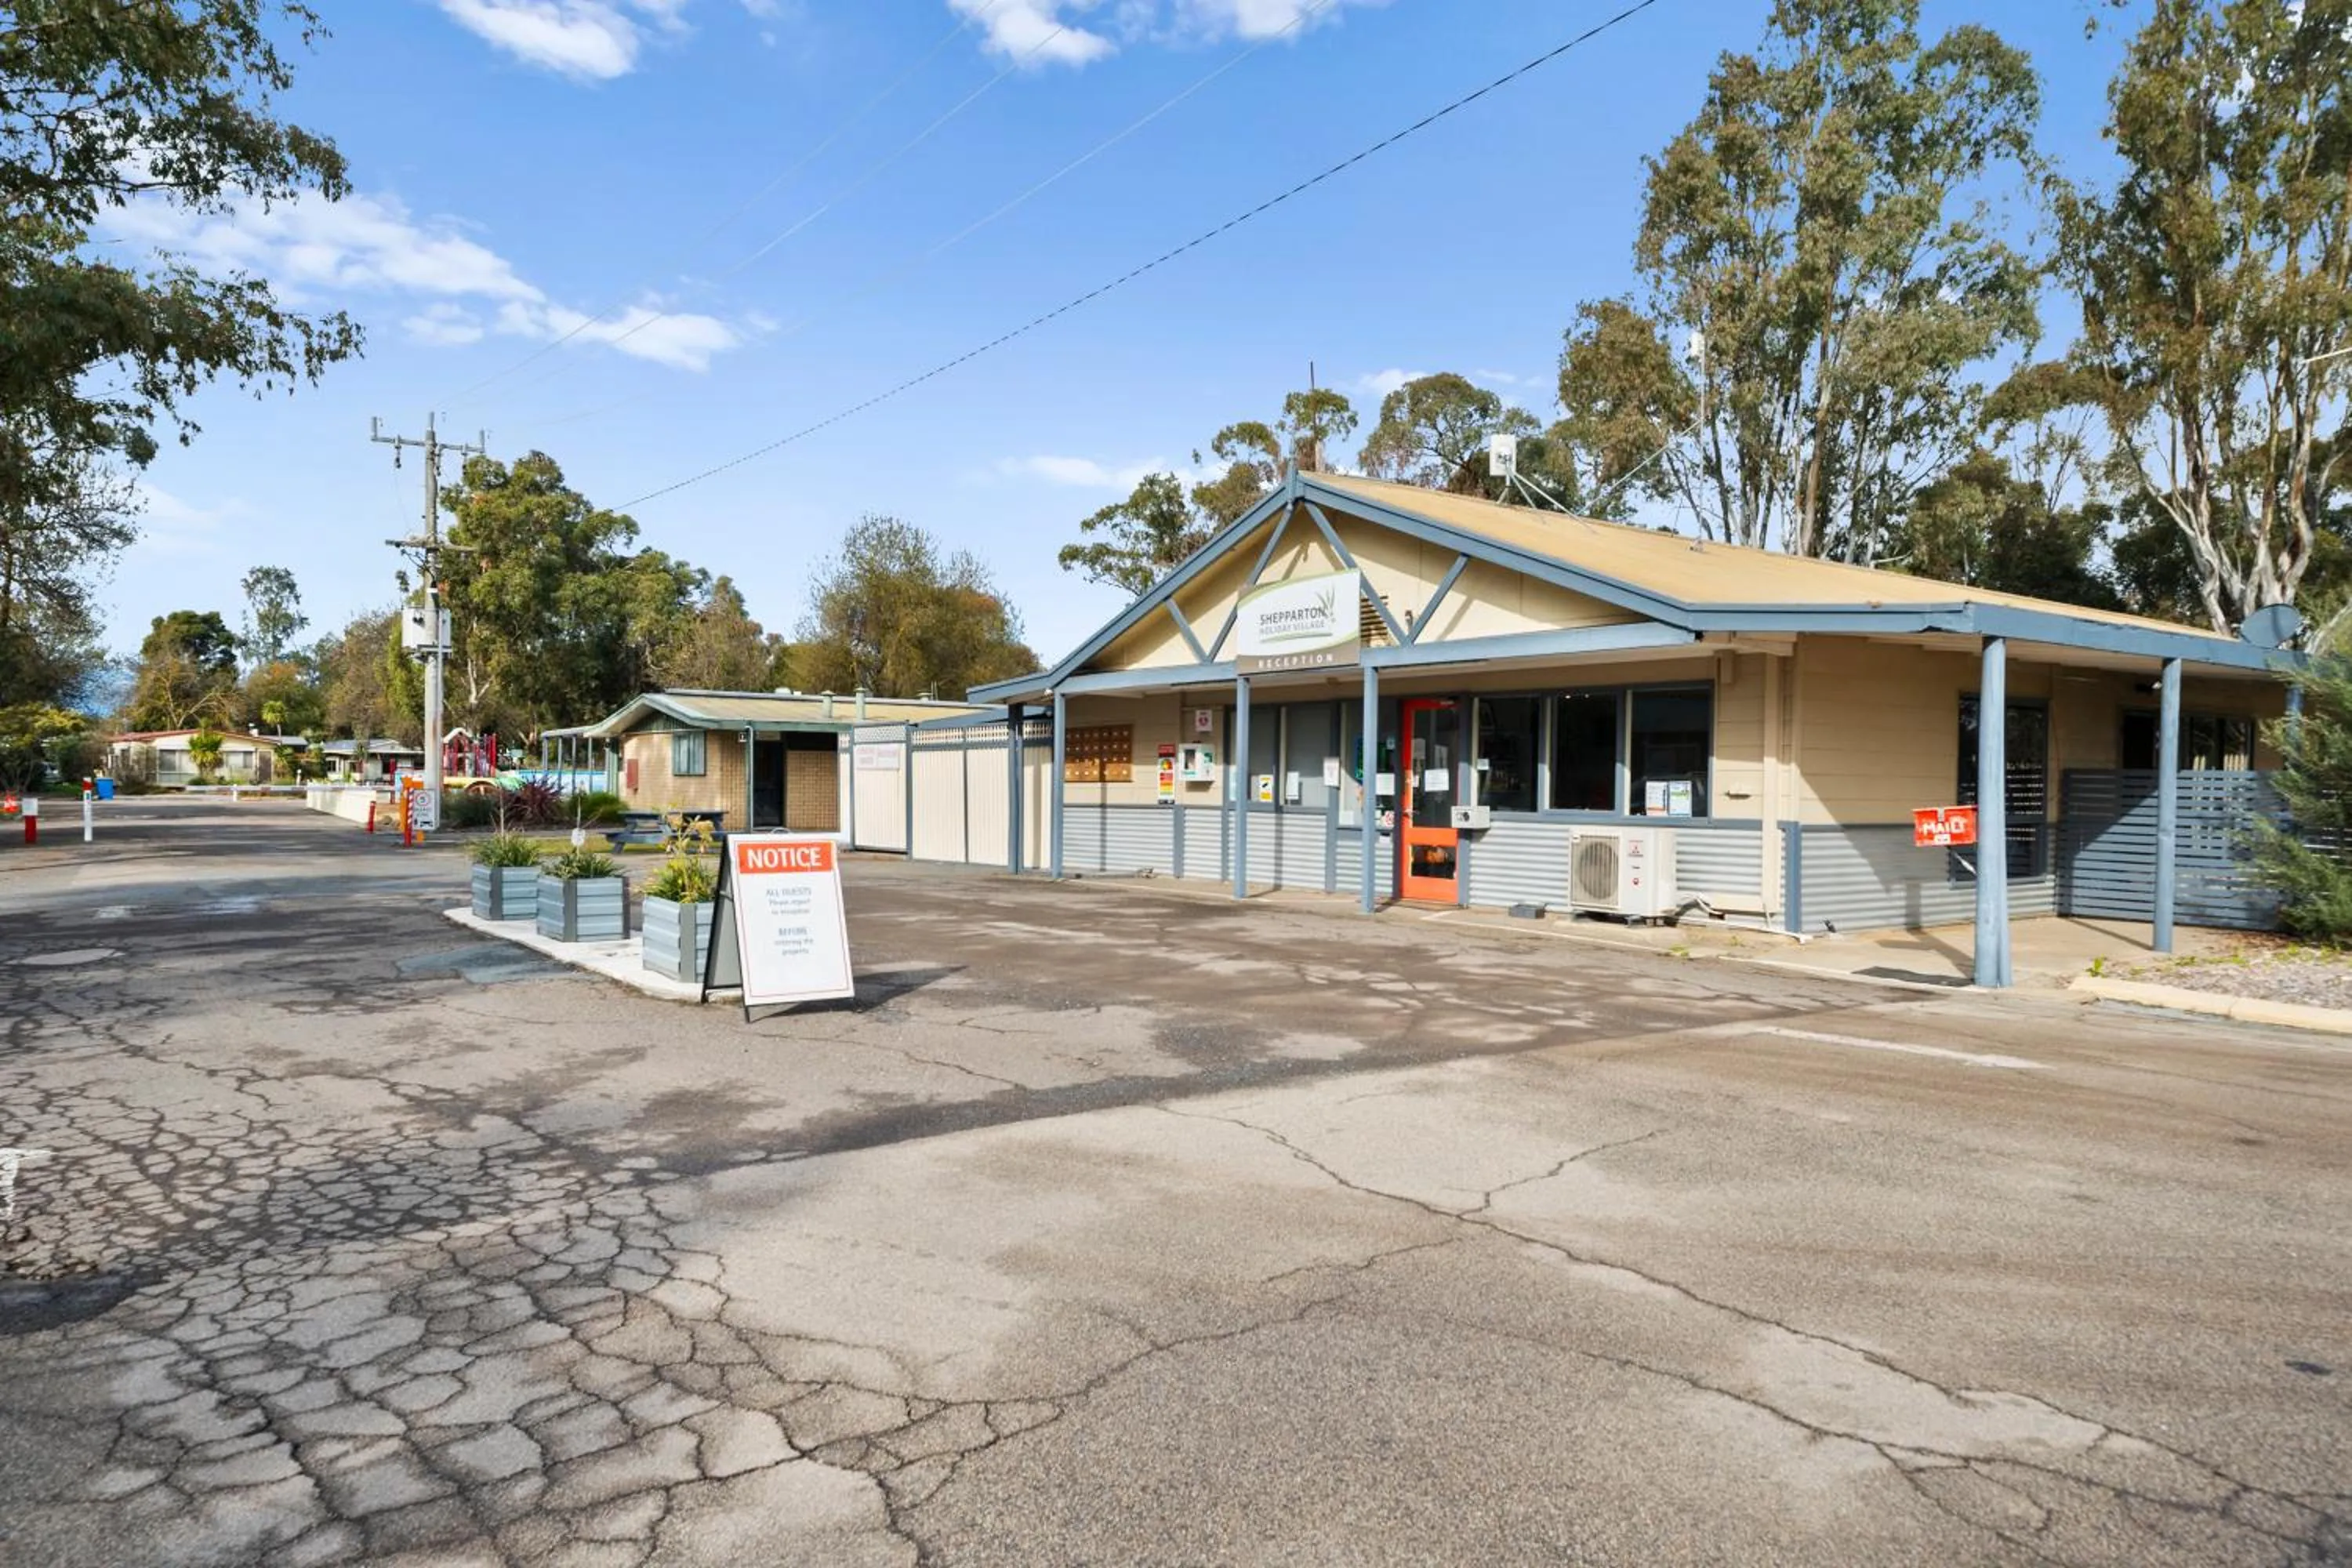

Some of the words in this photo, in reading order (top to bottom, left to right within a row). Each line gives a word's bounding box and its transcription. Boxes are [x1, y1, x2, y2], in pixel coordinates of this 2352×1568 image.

[1260, 608, 1326, 626] SHEPPARTON
[1258, 653, 1334, 668] RECEPTION
[746, 847, 823, 869] NOTICE
